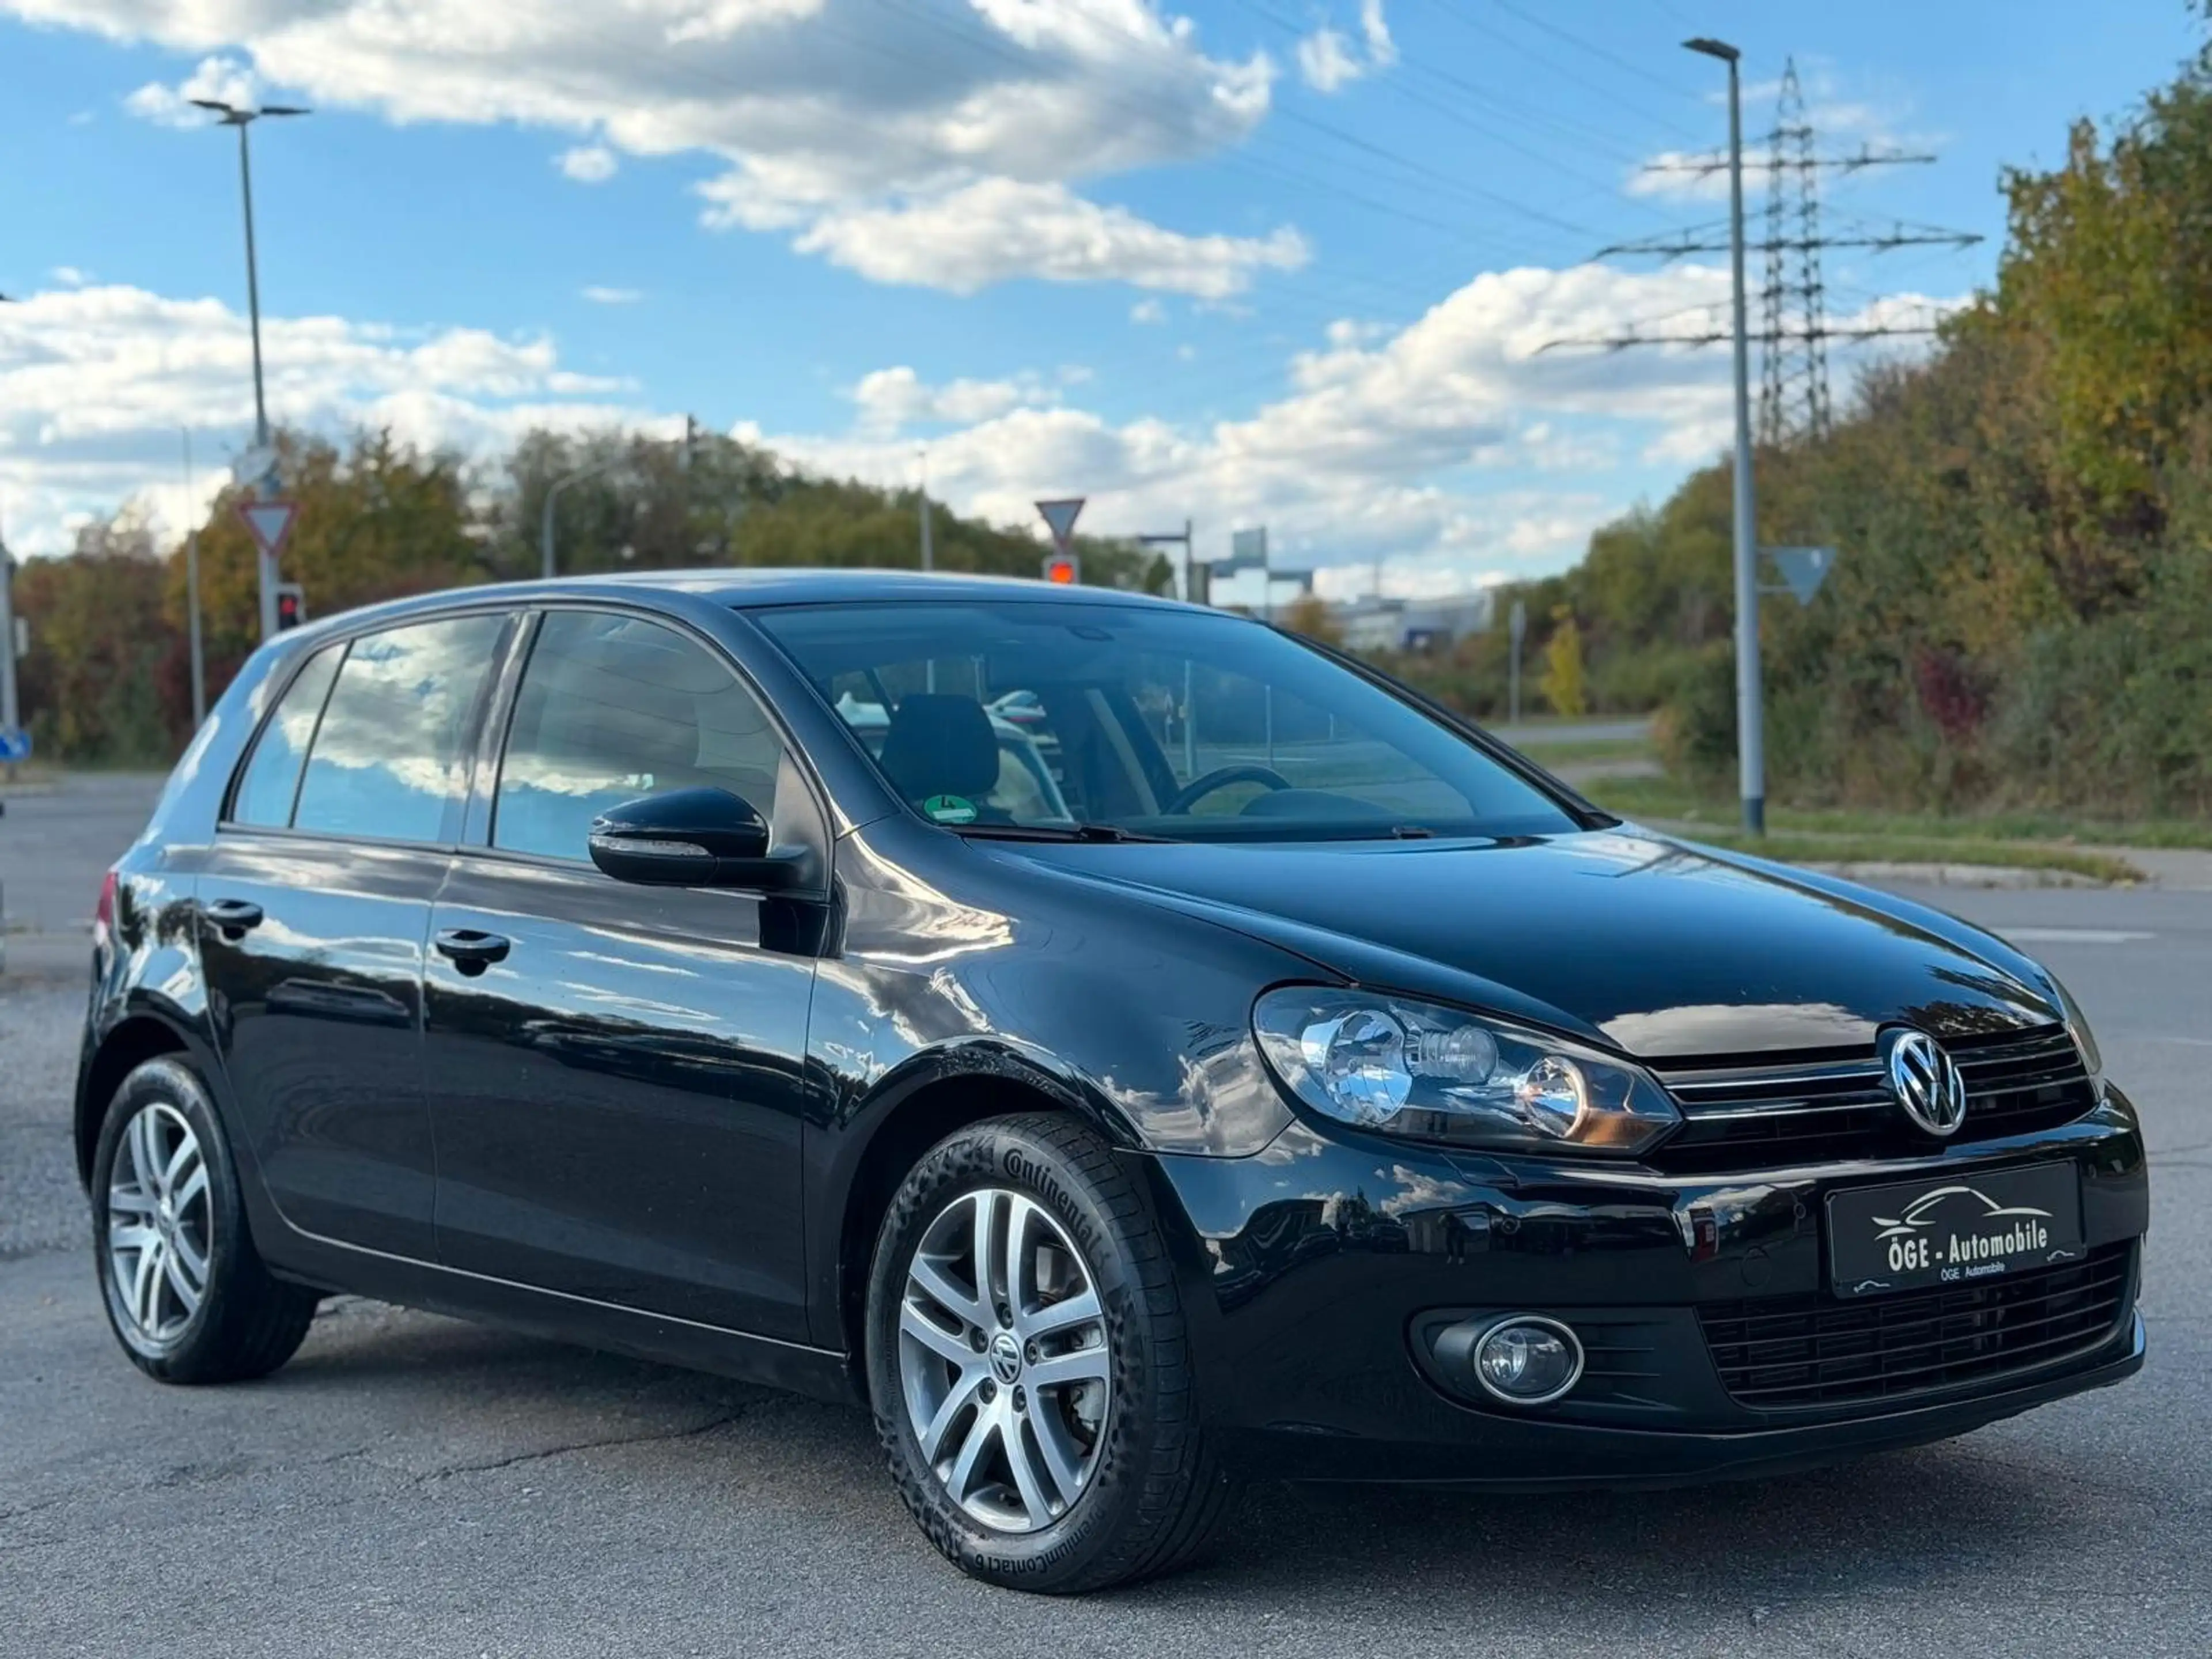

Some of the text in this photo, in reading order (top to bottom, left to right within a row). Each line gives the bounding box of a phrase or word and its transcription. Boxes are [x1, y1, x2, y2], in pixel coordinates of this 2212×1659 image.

[941, 796, 956, 810] 4
[1003, 1149, 1102, 1253] Continental
[1888, 1218, 2048, 1271] ÖGE - Automobile
[1965, 1261, 2005, 1278] Automobile
[975, 1553, 985, 1571] 6
